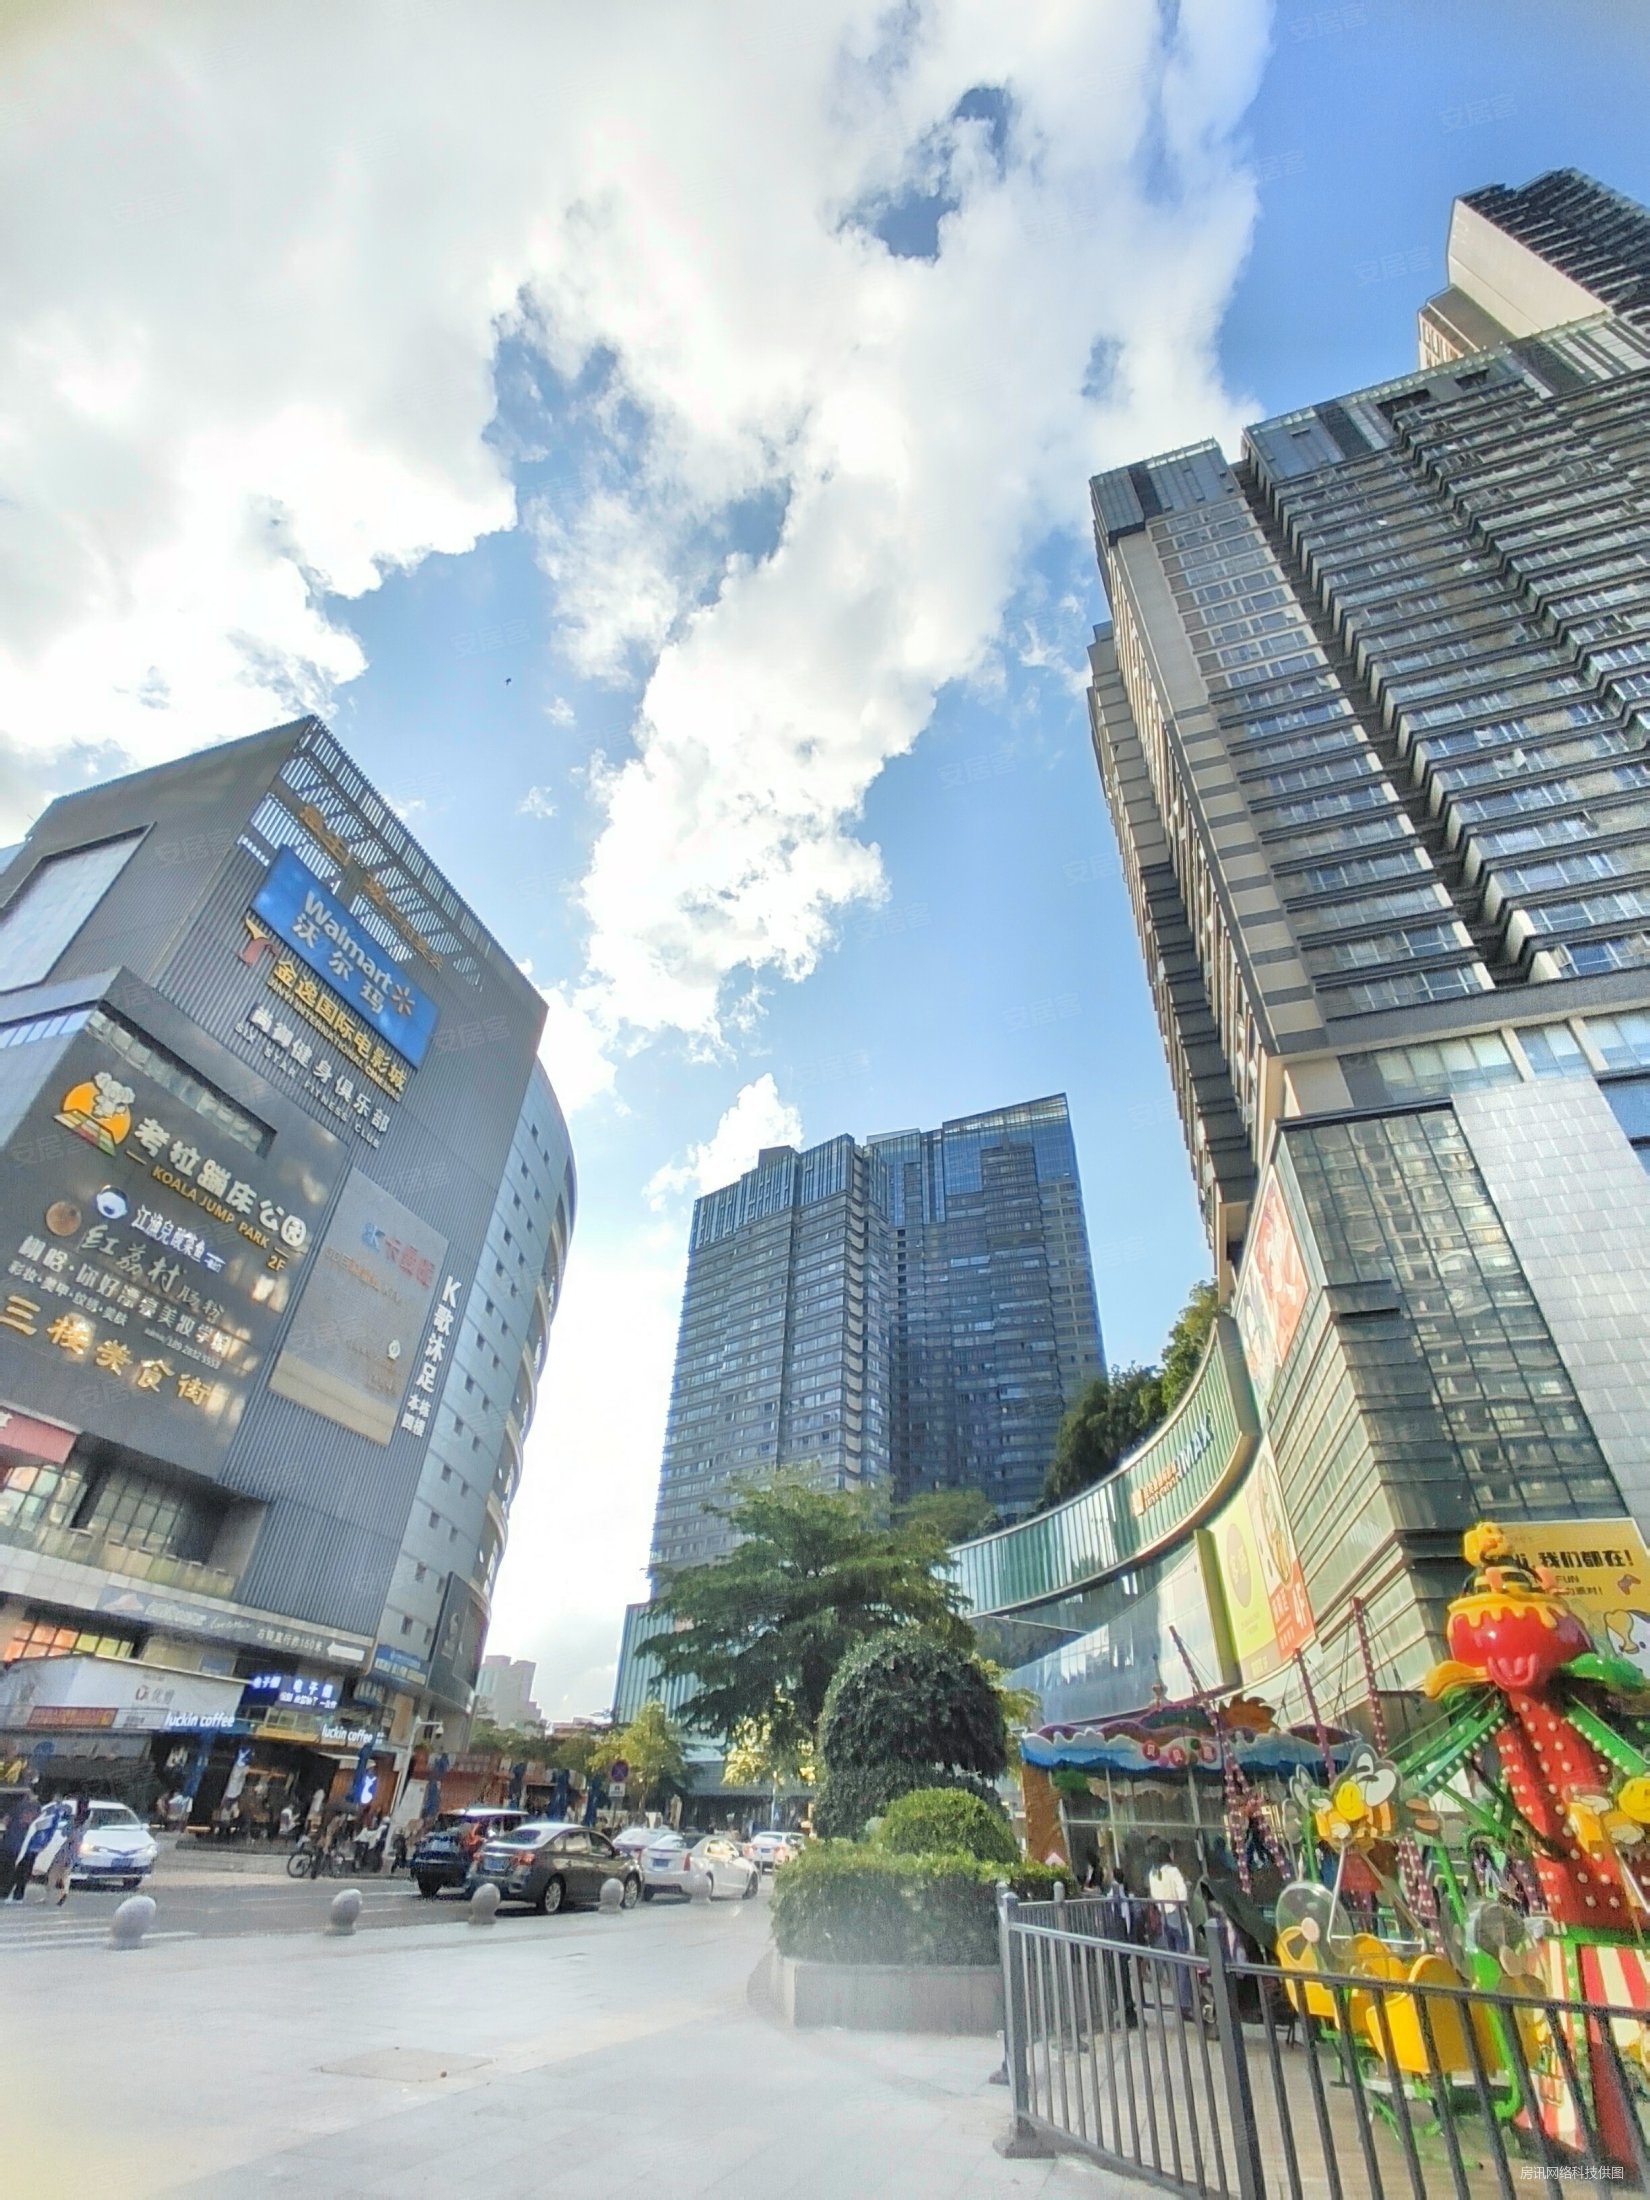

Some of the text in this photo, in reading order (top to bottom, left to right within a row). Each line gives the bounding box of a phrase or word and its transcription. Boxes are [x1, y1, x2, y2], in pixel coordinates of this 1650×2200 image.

[292, 912, 386, 1015] 沃尔玛
[303, 890, 395, 991] Walmart
[272, 958, 408, 1092] 金逸国际电影城
[303, 1081, 350, 1123] FITNESS
[354, 1123, 381, 1149] CLUB
[134, 1117, 308, 1248] 考拉蹦床公园
[151, 1165, 271, 1250] KOALA JUMP PARK
[80, 1223, 182, 1293] 红荔村
[267, 1254, 287, 1272] 2F
[177, 1283, 225, 1325] 肠粉
[415, 1274, 463, 1394] K歌沐足
[0, 1294, 213, 1406] 三楼美食街
[1176, 1410, 1214, 1478] IMAX
[1555, 1575, 1580, 1583] FUN
[165, 1711, 235, 1728] luckin coffee
[321, 1724, 347, 1741] luckin
[347, 1728, 373, 1744] coffee
